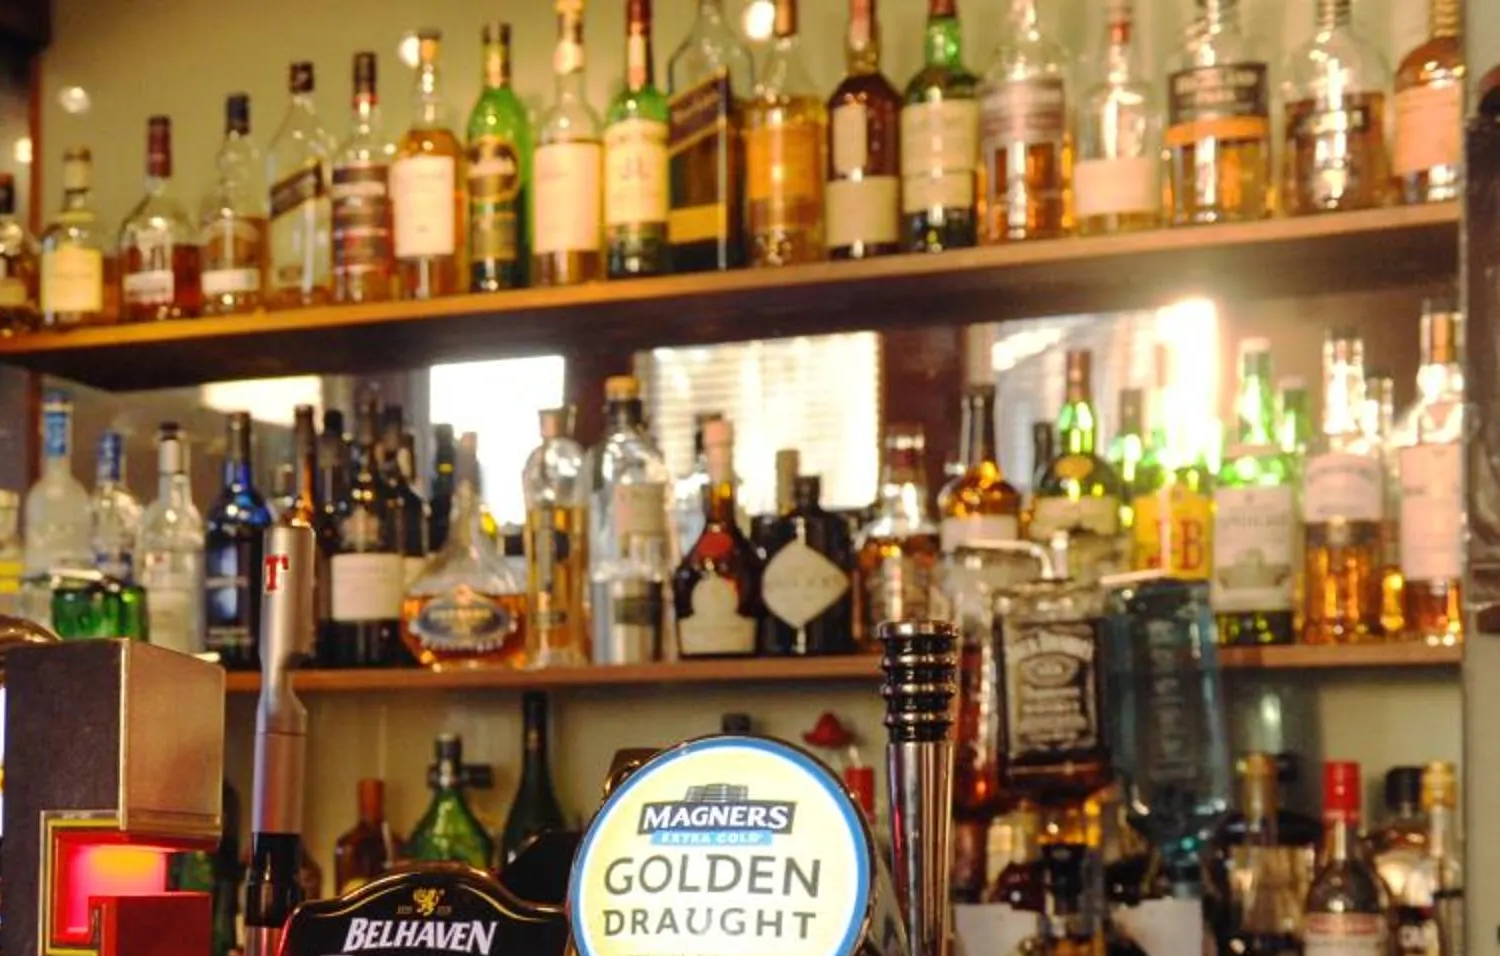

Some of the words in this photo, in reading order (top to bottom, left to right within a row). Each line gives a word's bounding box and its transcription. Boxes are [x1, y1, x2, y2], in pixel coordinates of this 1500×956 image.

[642, 805, 790, 831] MAGNERS
[661, 831, 712, 844] EXTRA
[716, 832, 763, 845] COLD
[604, 853, 821, 898] GOLDEN
[343, 917, 499, 956] BELHAVEN
[603, 908, 817, 939] DRAUGHT
